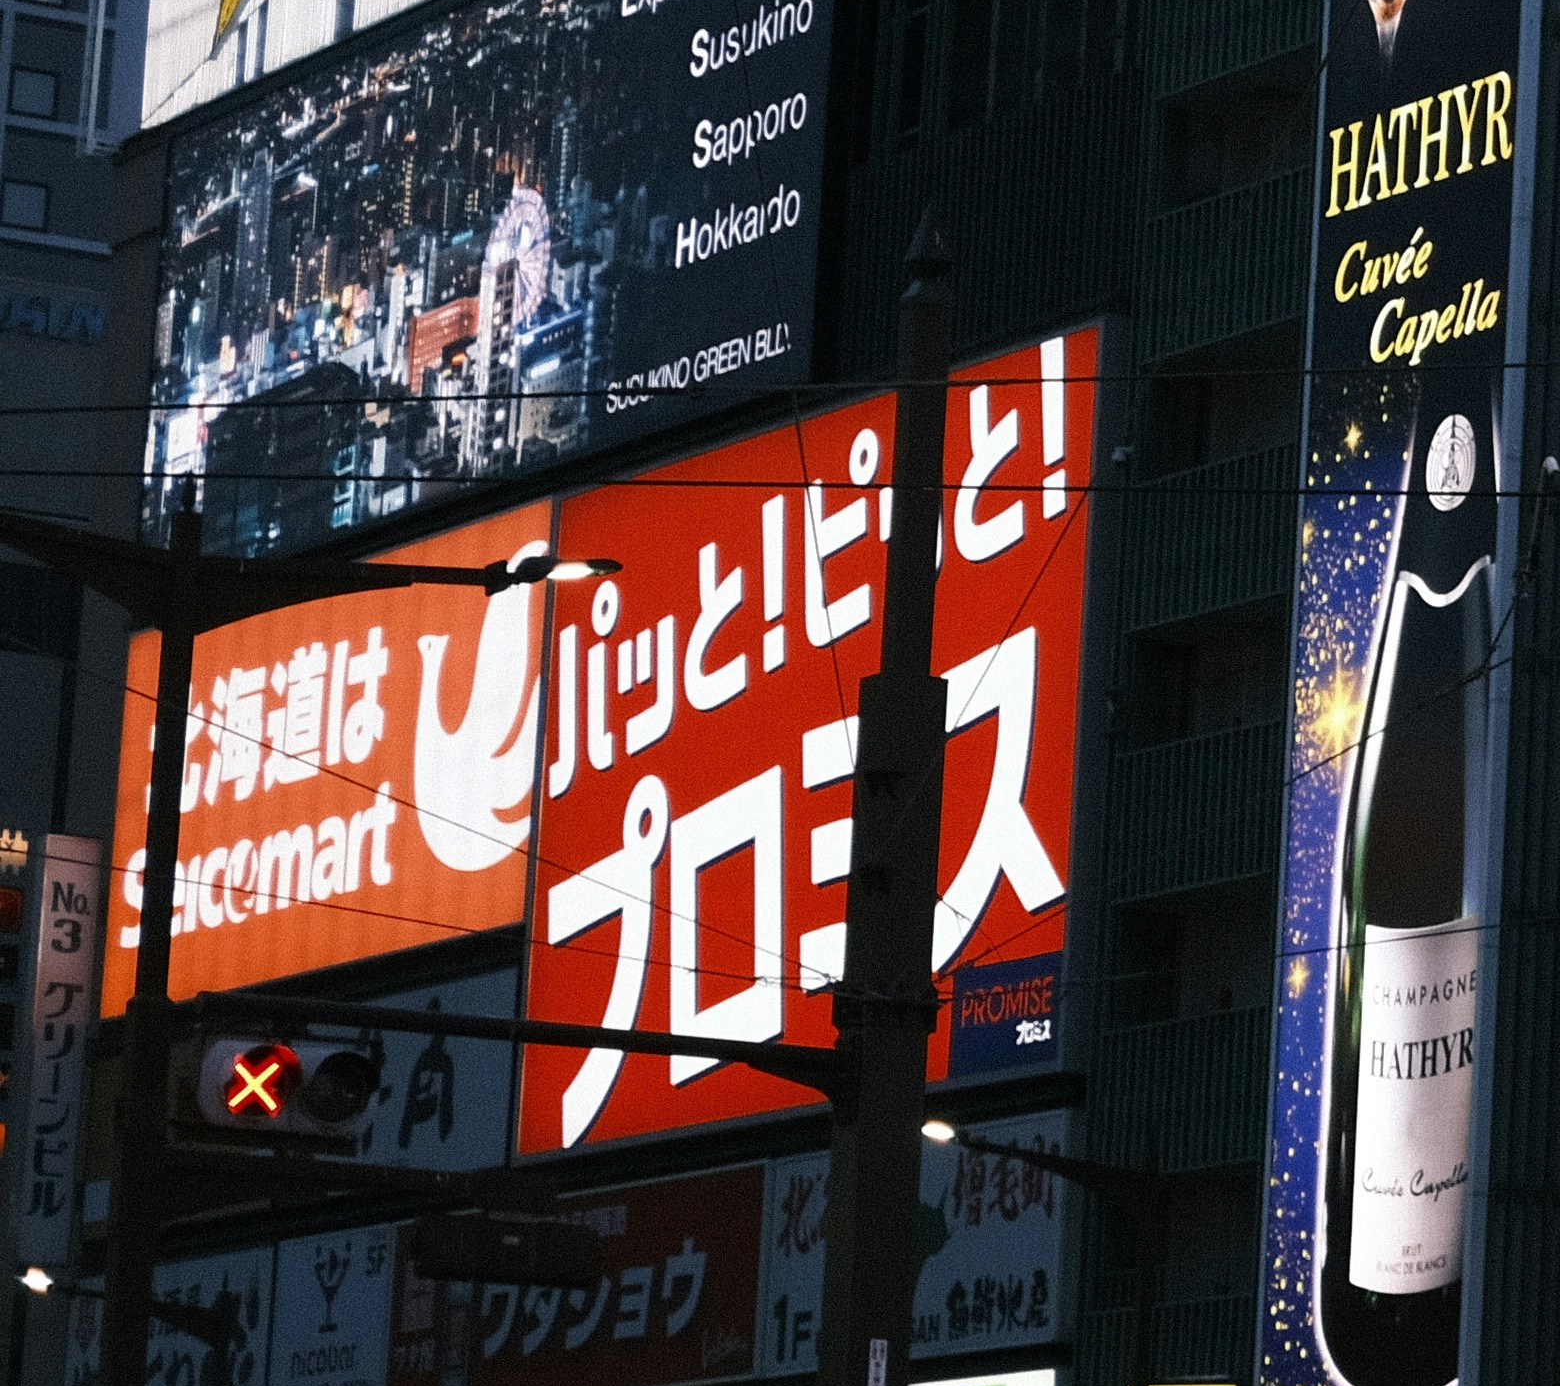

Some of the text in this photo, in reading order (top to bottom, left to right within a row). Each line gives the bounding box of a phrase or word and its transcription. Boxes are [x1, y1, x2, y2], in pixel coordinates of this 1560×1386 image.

[692, 92, 806, 168] Sapporo
[1326, 69, 1512, 218] HATHYR
[675, 189, 799, 269] Hokkaido
[1335, 226, 1432, 303] Cuvée
[694, 336, 750, 385] GREEN
[1370, 279, 1500, 366] Capella
[549, 338, 1066, 795] パッと!ピと!
[959, 974, 1053, 1028] PROMISE
[1372, 969, 1476, 1008] CHAMPAGNE
[1369, 1027, 1473, 1079] HATHYR
[775, 1294, 814, 1364] 1F
